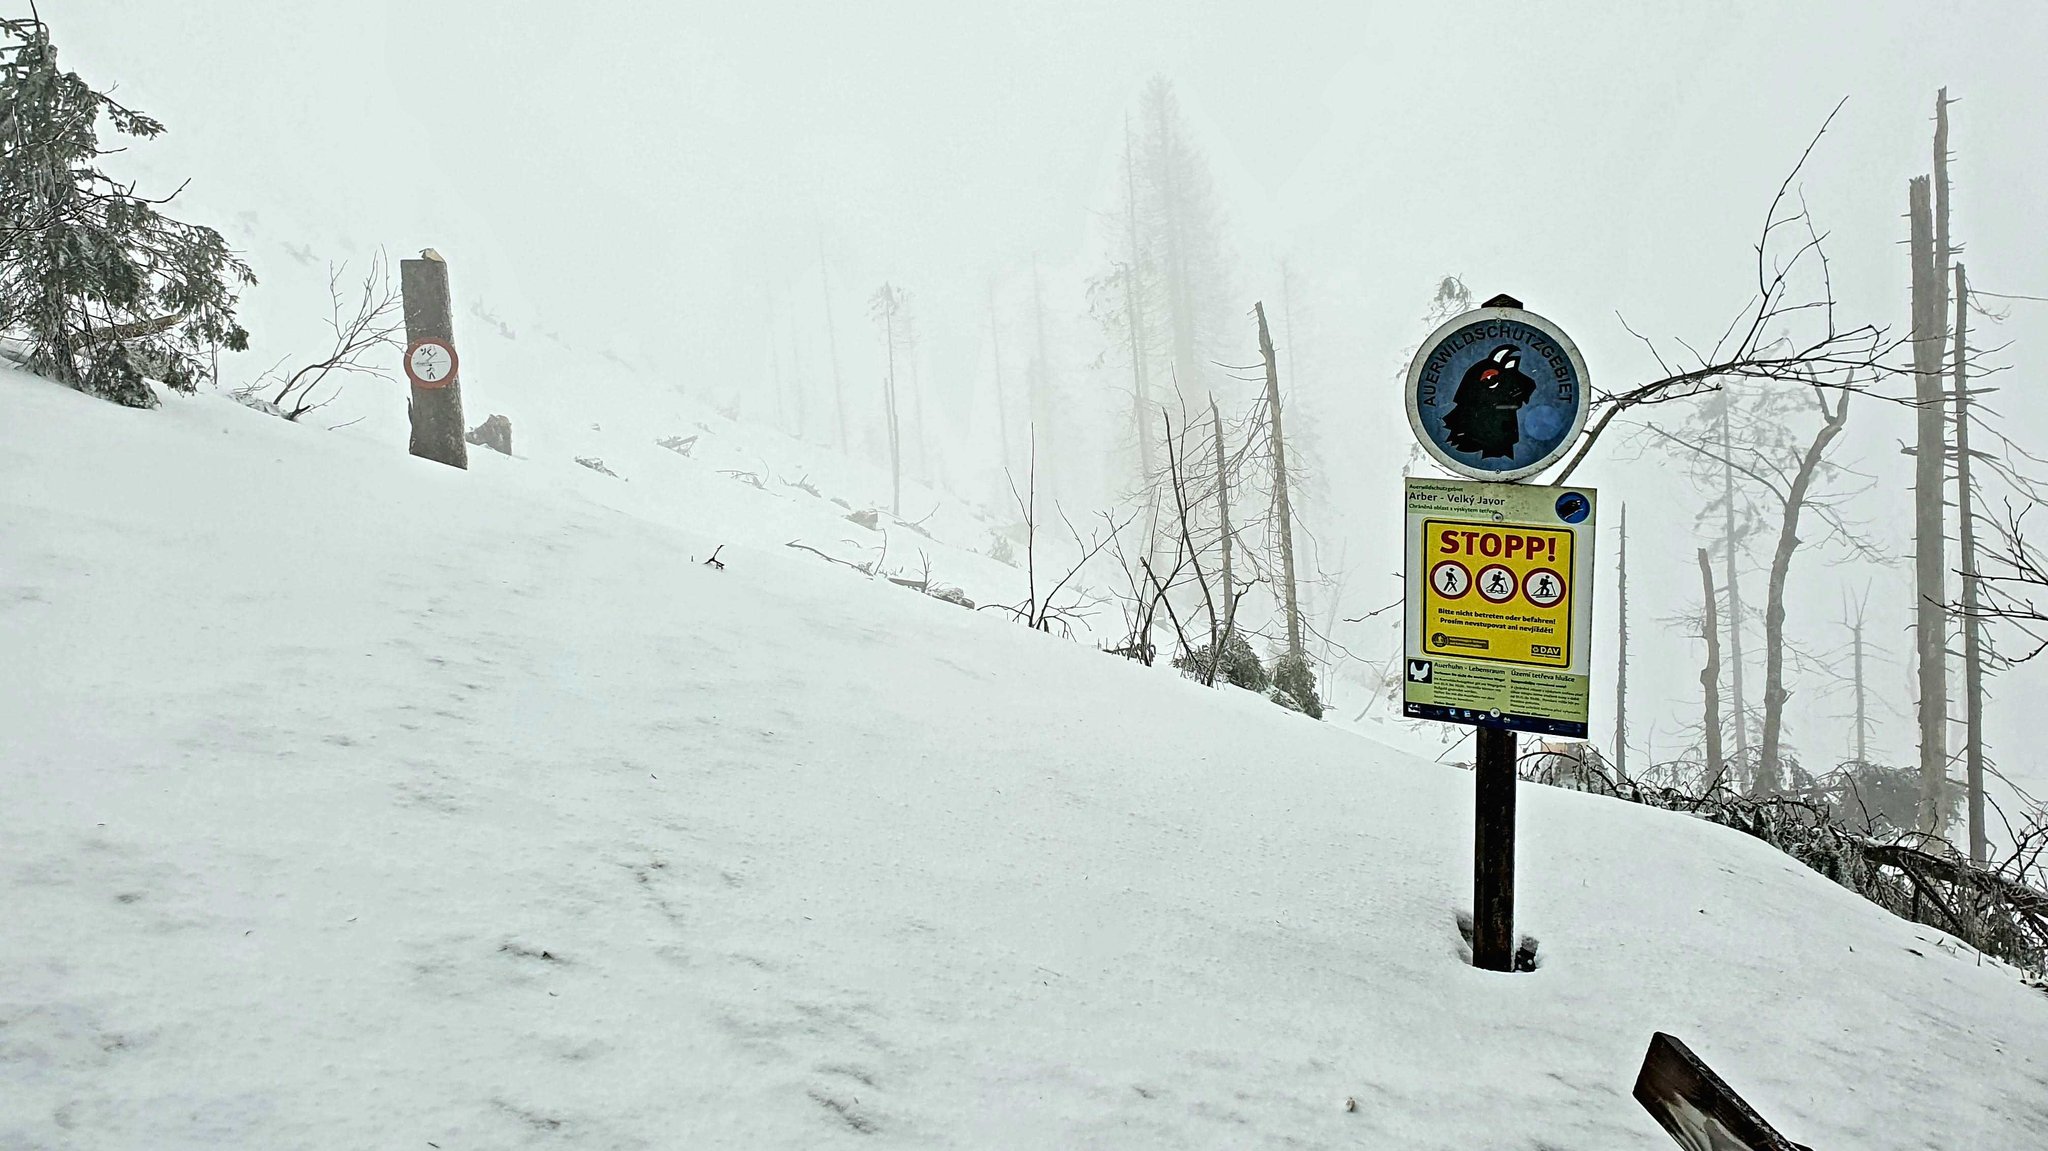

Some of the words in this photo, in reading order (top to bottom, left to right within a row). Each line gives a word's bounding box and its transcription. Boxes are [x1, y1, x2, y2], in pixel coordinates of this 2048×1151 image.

[1423, 325, 1573, 407] AUERWILDSCHUTZGEBIET
[1409, 492, 1437, 501] Arber
[1447, 494, 1475, 506] Velký
[1477, 496, 1505, 506] Javor
[1439, 530, 1557, 562] STOPP!
[1438, 608, 1454, 616] Bitte
[1455, 609, 1473, 617] nicht
[1474, 611, 1504, 620] betreten
[1505, 614, 1521, 622] oder
[1522, 615, 1556, 625] befahren!
[1440, 617, 1463, 625] Prosím
[1464, 620, 1506, 630] nevstupovat
[1540, 646, 1560, 655] DAV
[1434, 662, 1463, 670] Auerhuhn
[1469, 665, 1506, 675] Lebensraum
